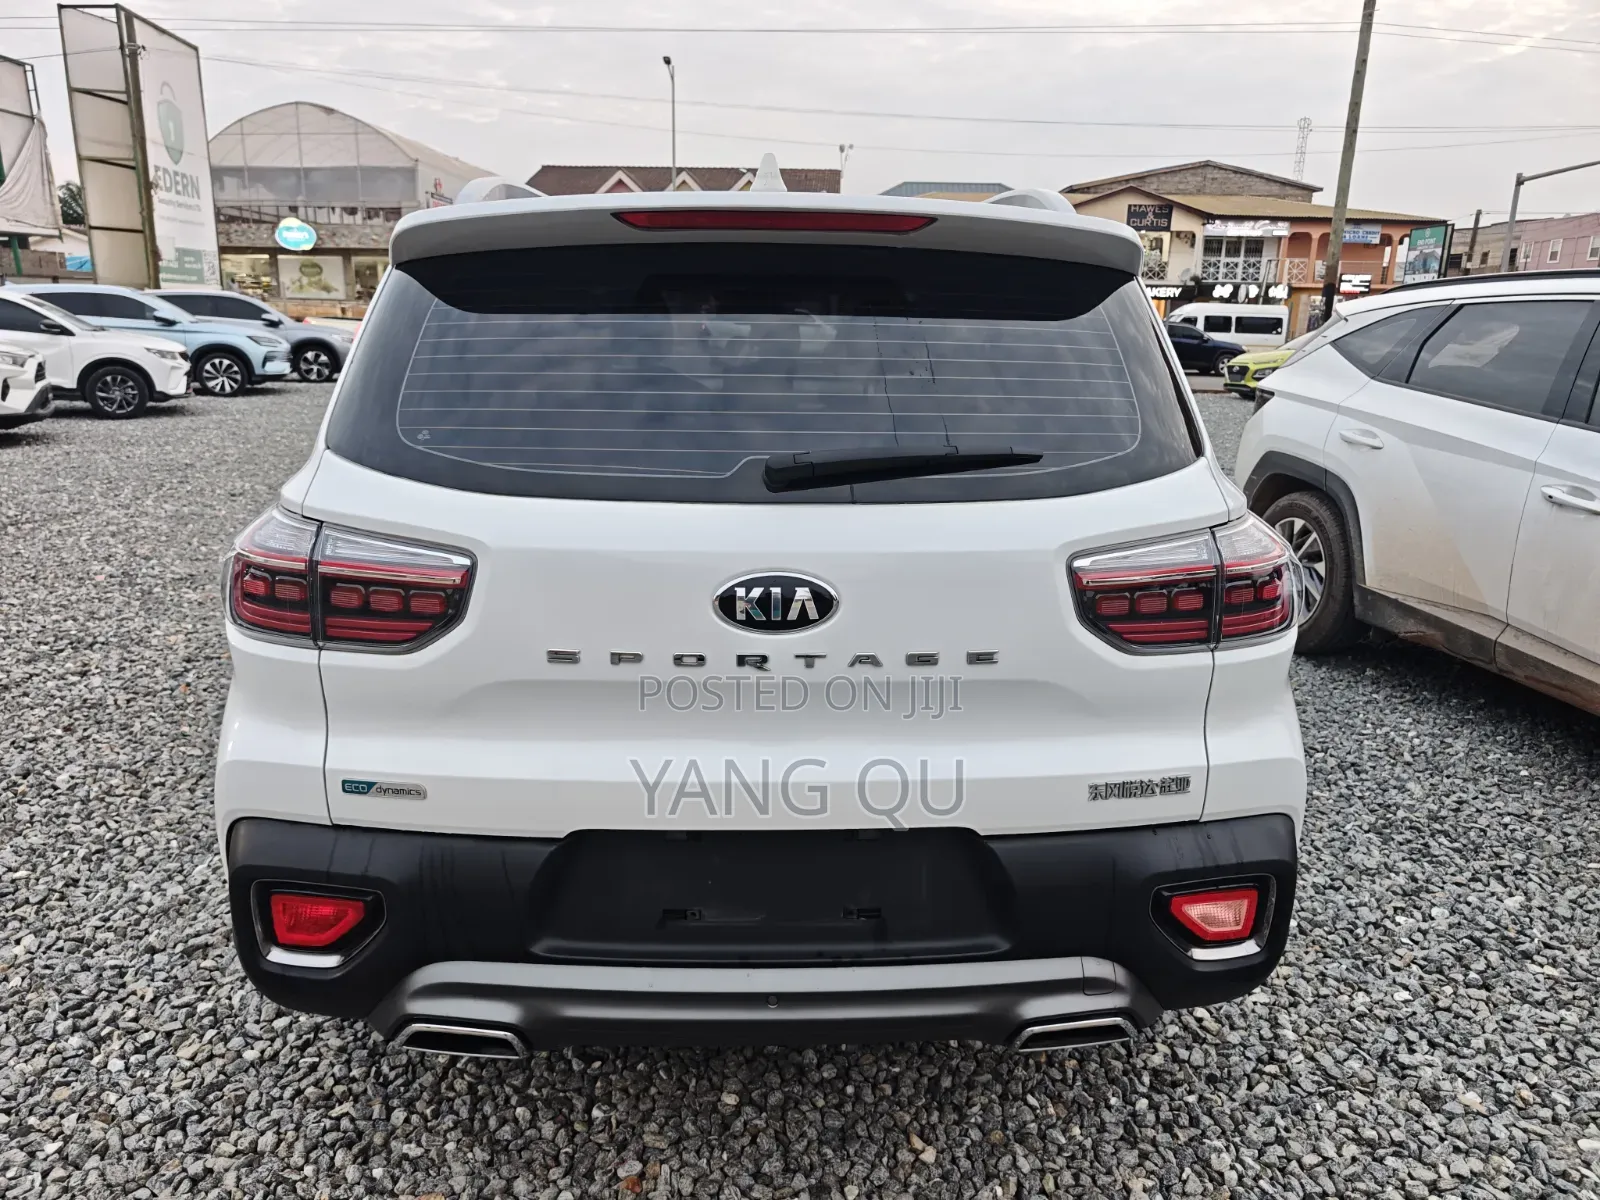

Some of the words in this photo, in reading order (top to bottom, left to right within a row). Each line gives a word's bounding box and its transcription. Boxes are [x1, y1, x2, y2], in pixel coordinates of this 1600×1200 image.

[1130, 204, 1169, 213] HAWES
[1146, 211, 1155, 220] &
[1130, 218, 1168, 227] CURTIS
[733, 586, 820, 621] KIA
[546, 647, 1000, 672] SPORTAGE
[344, 783, 368, 793] ECO
[375, 785, 422, 796] dynamics
